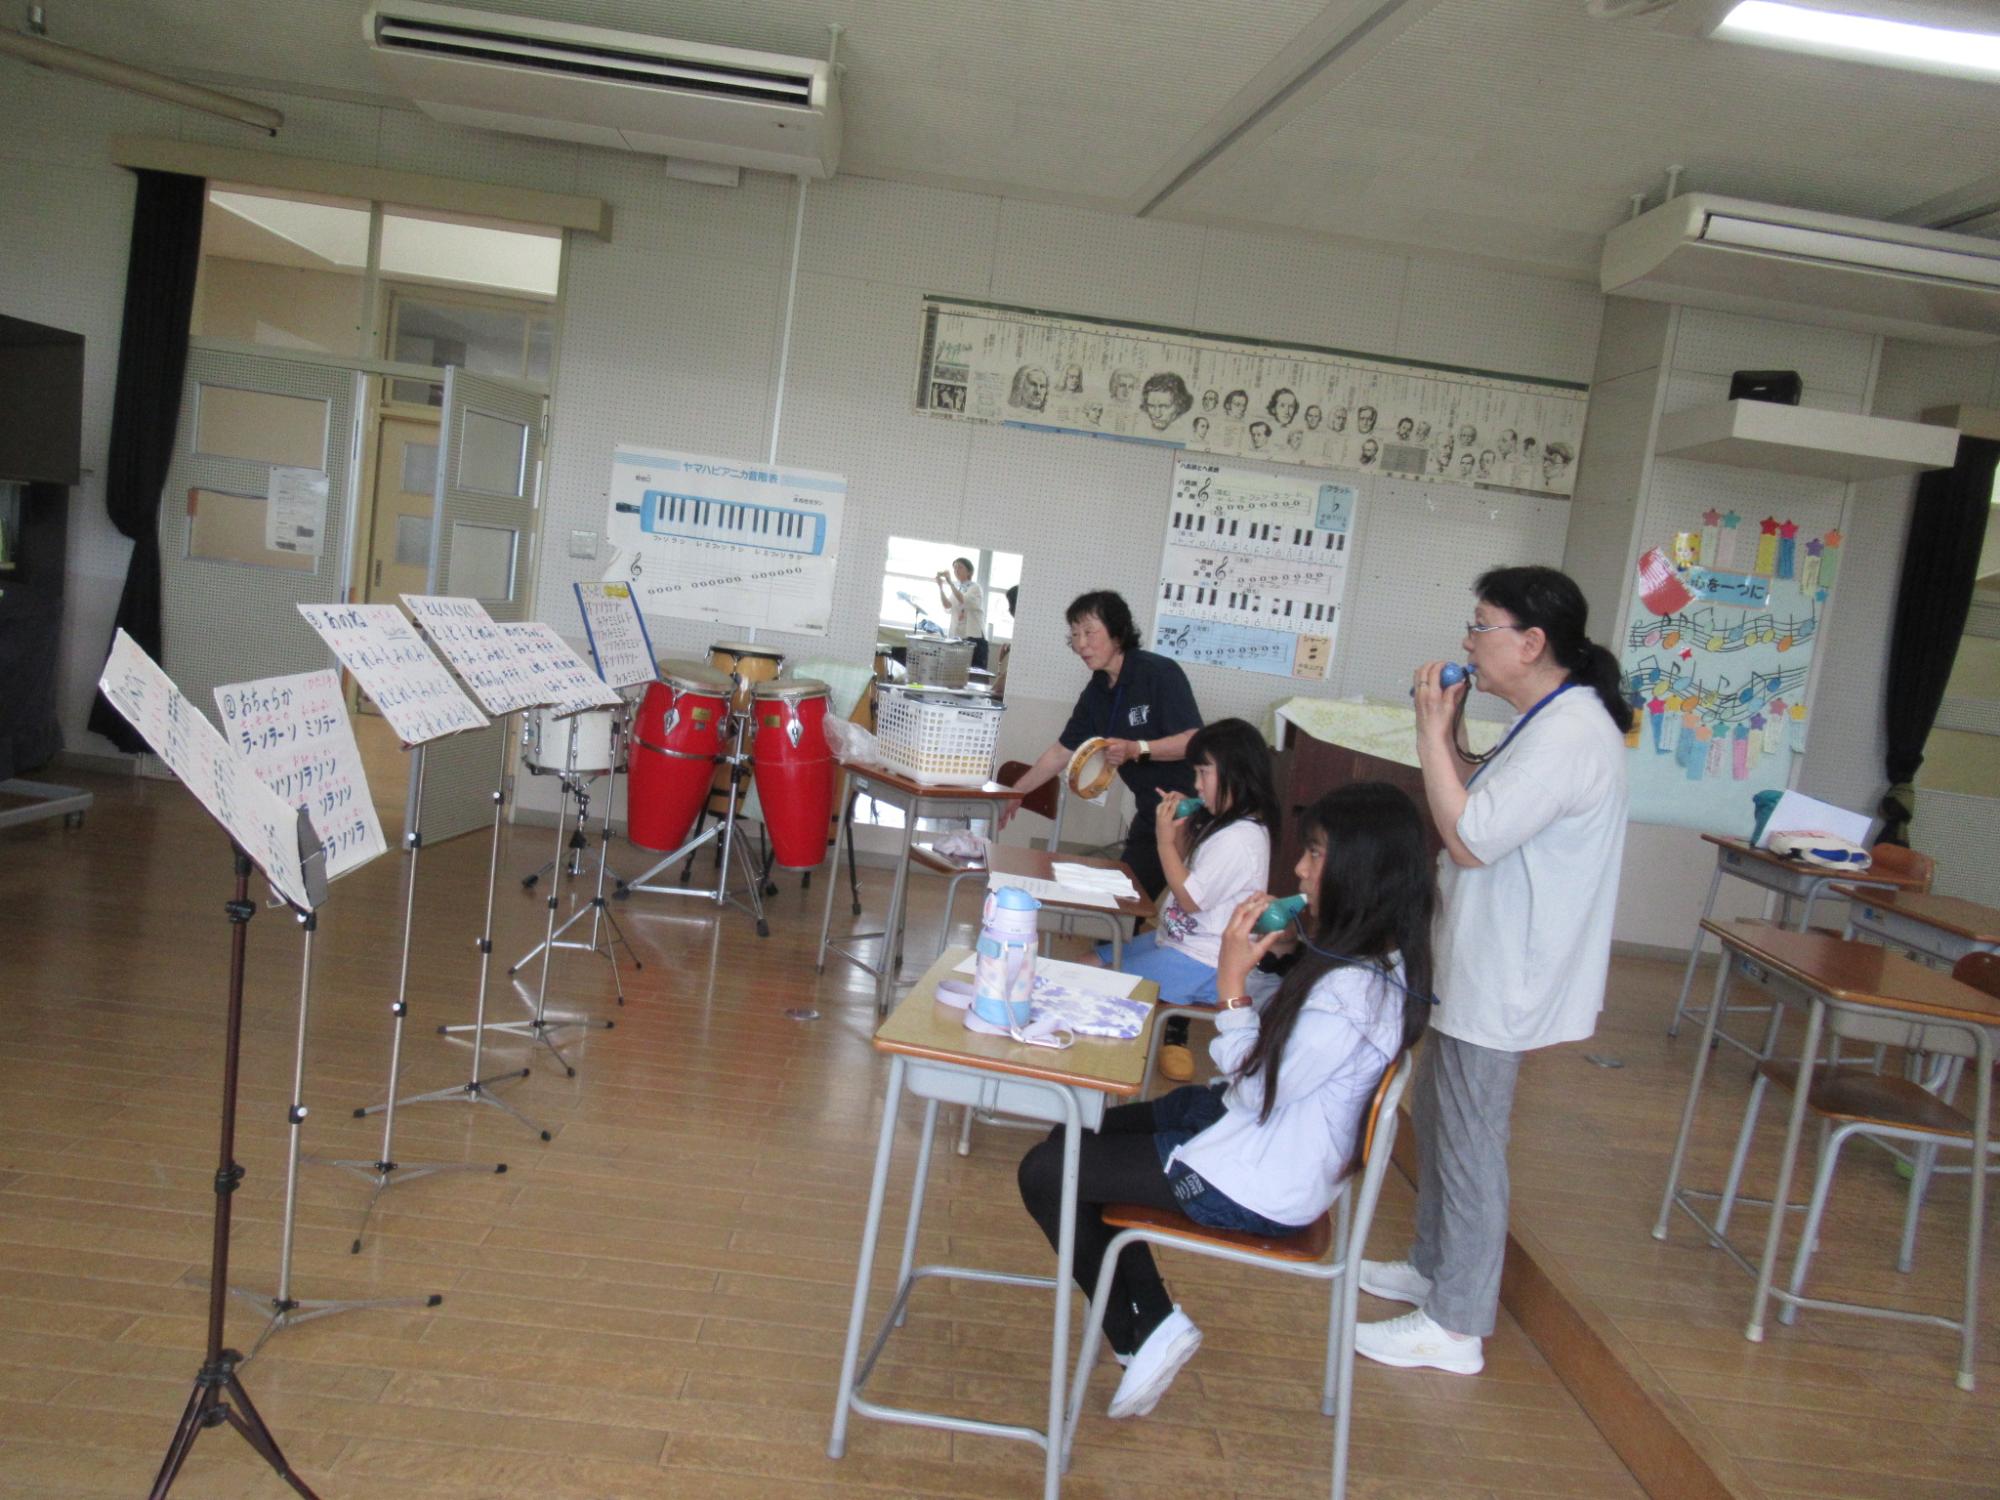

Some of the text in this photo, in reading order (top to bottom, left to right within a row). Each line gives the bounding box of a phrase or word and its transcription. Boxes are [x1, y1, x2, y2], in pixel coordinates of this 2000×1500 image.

[239, 687, 293, 717] おちゃらか
